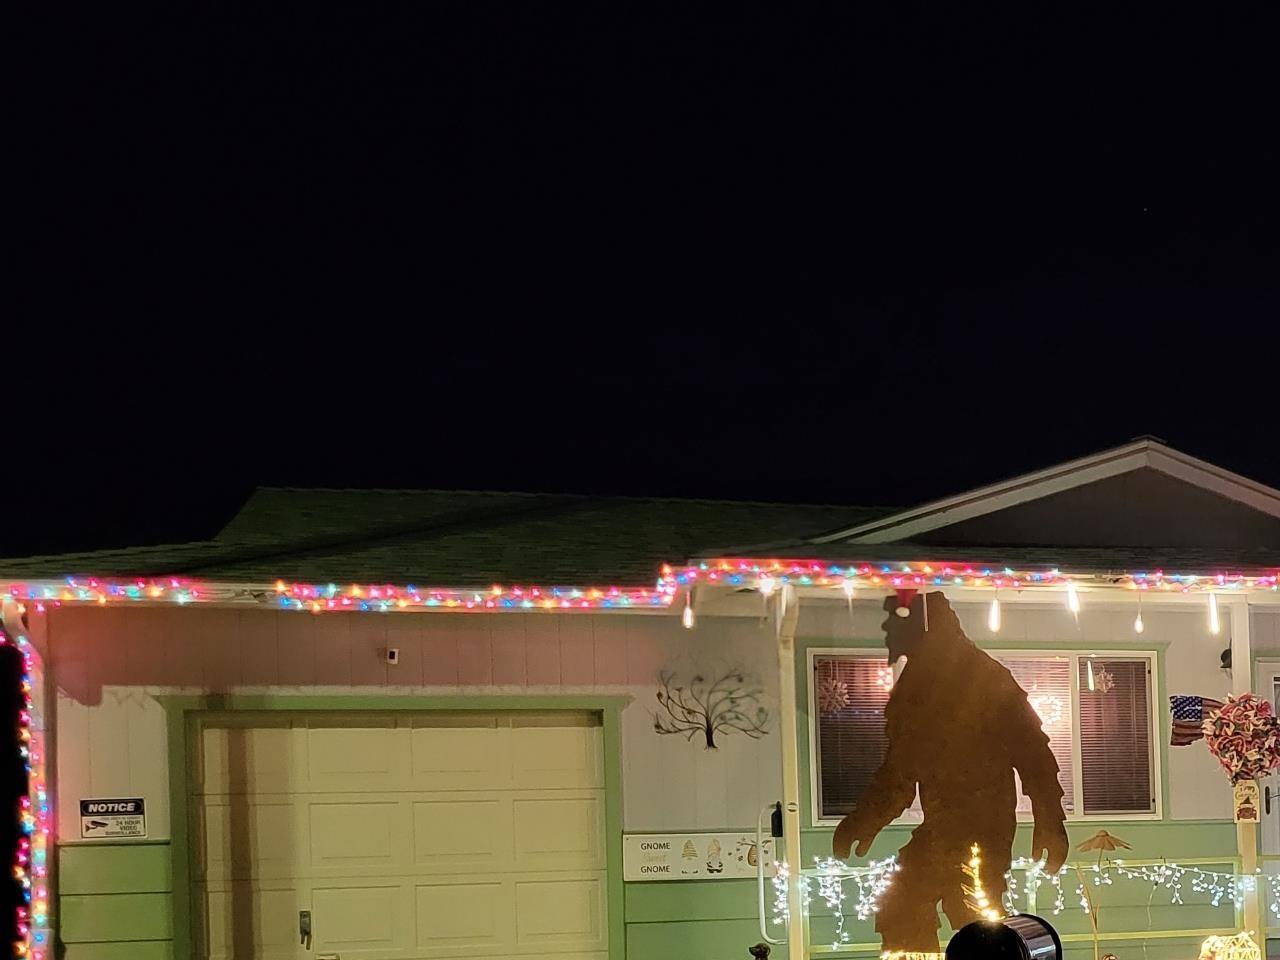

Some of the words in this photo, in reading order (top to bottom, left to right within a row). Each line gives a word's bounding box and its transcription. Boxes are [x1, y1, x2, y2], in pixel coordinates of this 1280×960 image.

[88, 803, 136, 812] NOTICE
[641, 842, 671, 850] GNOME
[641, 865, 671, 873] GNOME
